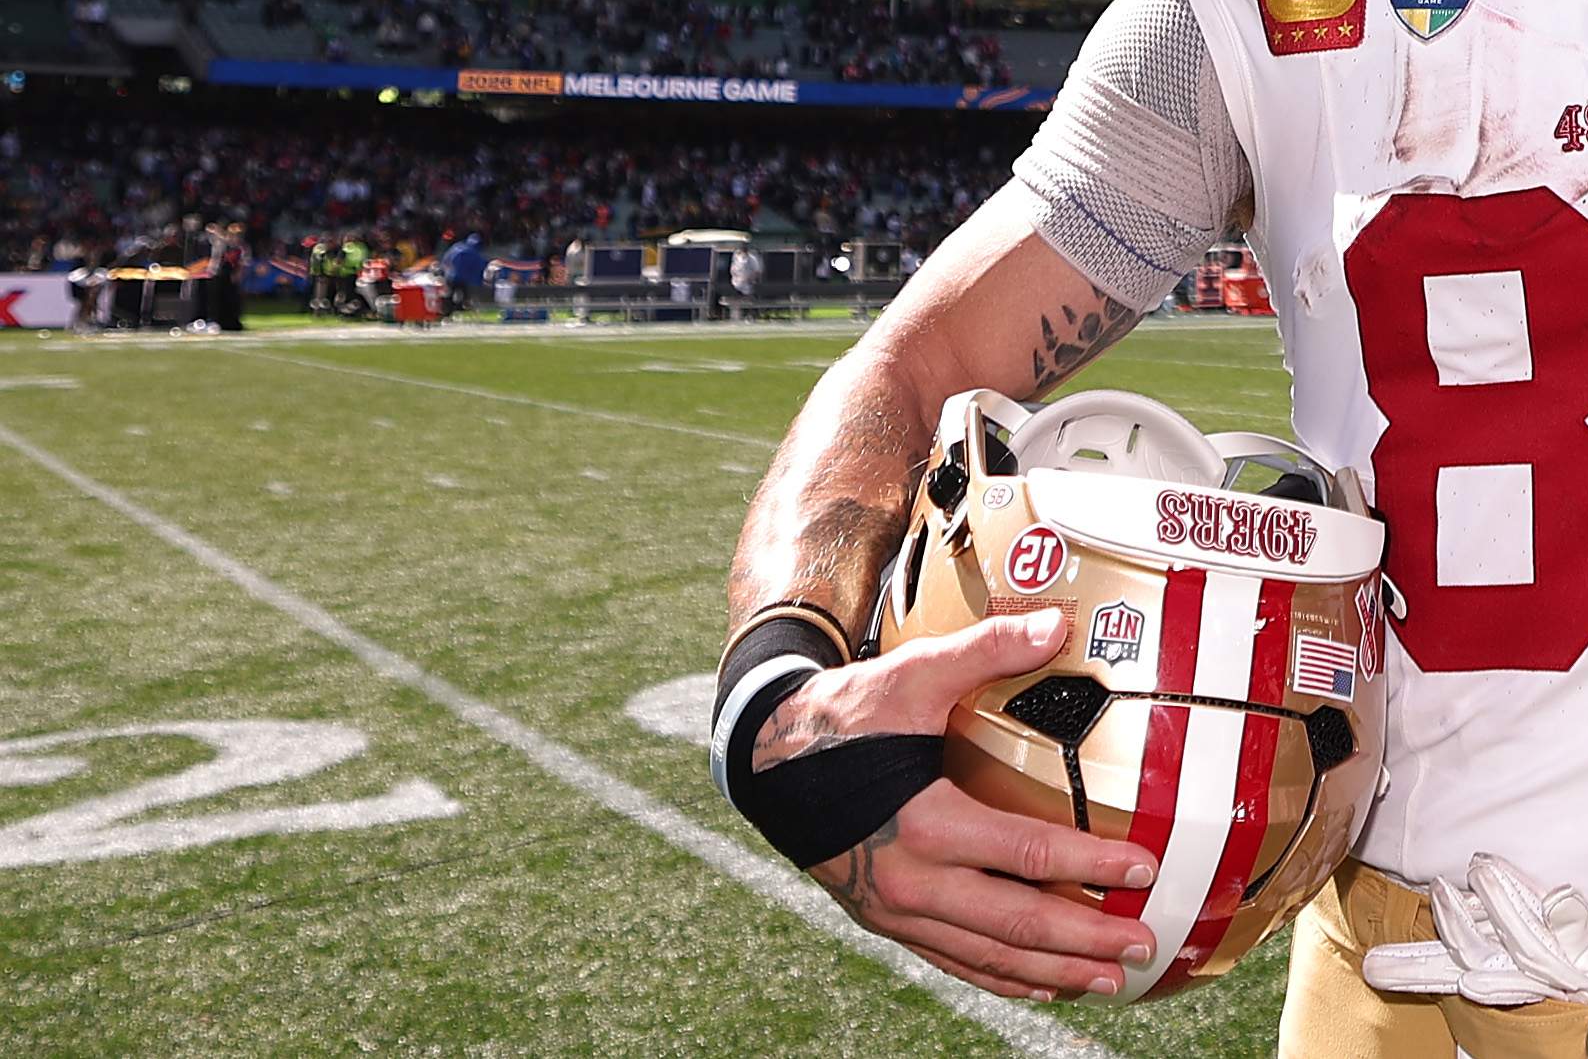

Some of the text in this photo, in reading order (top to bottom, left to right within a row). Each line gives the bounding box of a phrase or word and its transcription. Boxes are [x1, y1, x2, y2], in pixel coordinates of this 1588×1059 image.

[565, 72, 721, 100] MELBOURNE
[723, 80, 796, 103] GAME
[1157, 490, 1317, 565] 49ERS
[1013, 536, 1058, 582] 12
[1099, 608, 1140, 640] NFL
